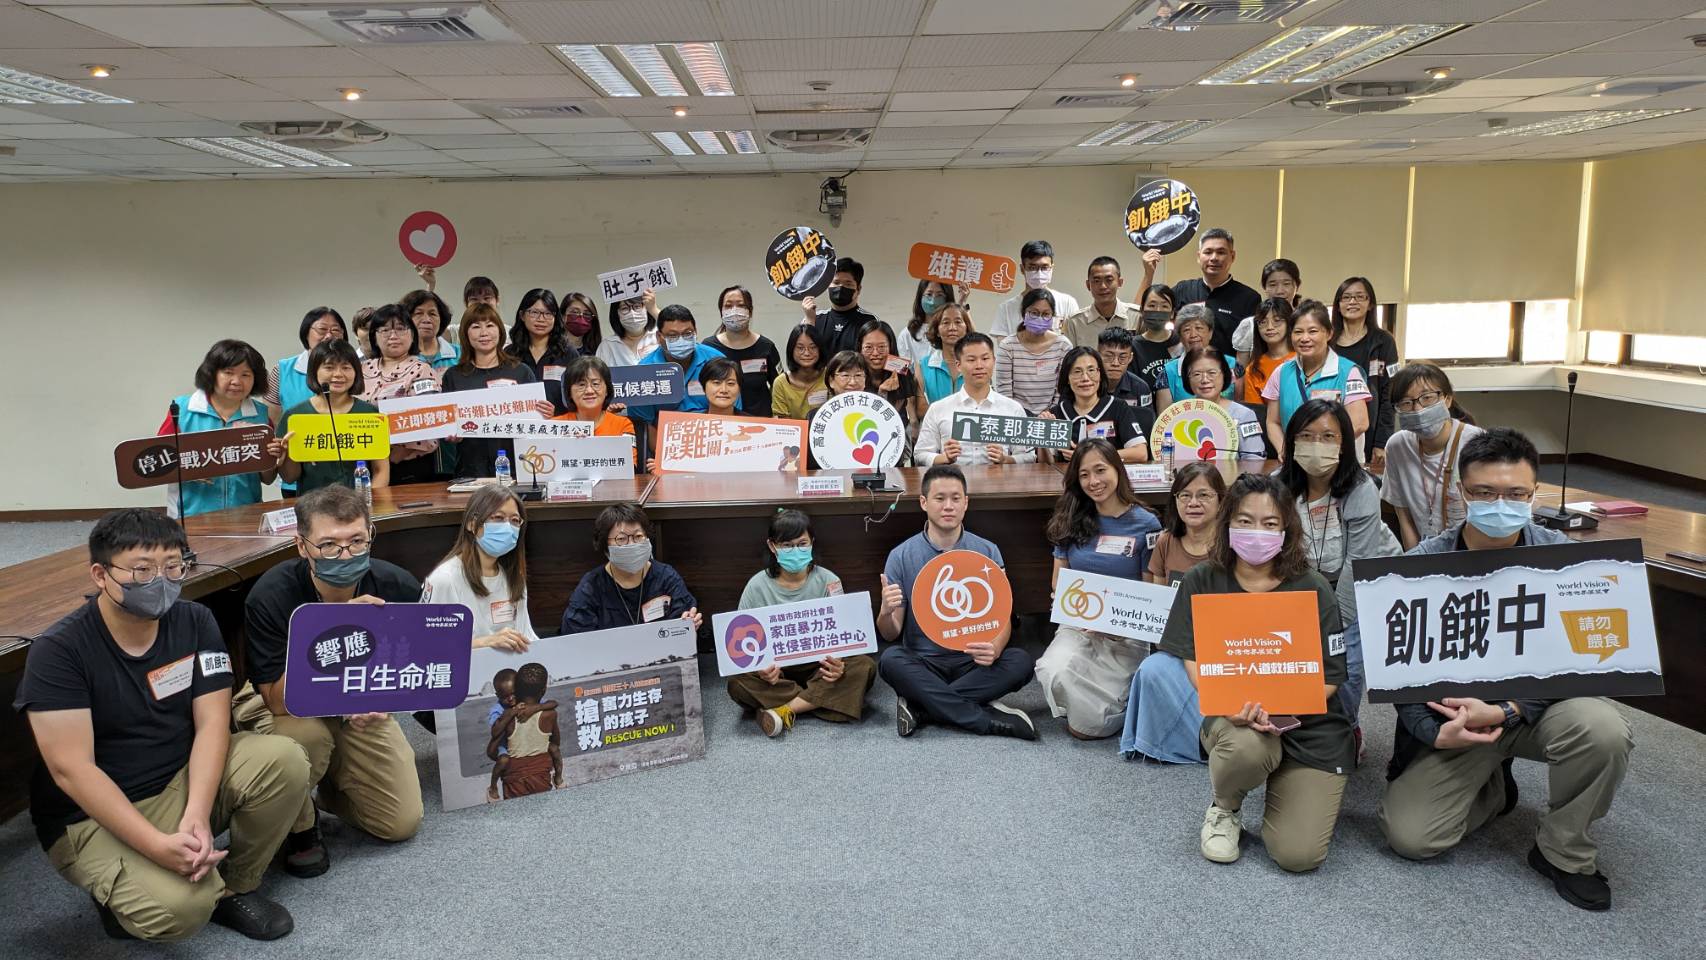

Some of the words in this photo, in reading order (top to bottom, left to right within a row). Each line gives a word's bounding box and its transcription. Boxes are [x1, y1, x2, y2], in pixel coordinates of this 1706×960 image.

[1128, 192, 1191, 232] 飢餓中
[770, 233, 820, 287] 飢餓中
[603, 266, 671, 299] 肚子餓
[813, 394, 895, 448] 高雄市政府社會局
[980, 416, 1069, 441] 泰郡建設
[304, 433, 373, 450] #飢餓中
[980, 434, 1006, 443] TAIJUN
[1010, 437, 1068, 447] CONSTRUCTION
[139, 449, 177, 475] 停止
[180, 443, 261, 470] 戰火衝突
[1556, 581, 1581, 590] World
[1584, 580, 1610, 588] Vision
[769, 606, 834, 623] 高雄市政府社會局
[1111, 606, 1142, 620] World
[1145, 612, 1168, 625] Visio
[1385, 584, 1546, 667] 飢餓中
[1578, 616, 1611, 631] 請勿
[770, 617, 837, 639] 家庭暴力及
[315, 631, 371, 667] 響應
[772, 629, 866, 655] 性侵害防治中心
[1225, 638, 1252, 647] World
[1254, 637, 1281, 646] Vision
[1587, 633, 1621, 649] 餵食
[312, 662, 451, 693] 一日生命糧
[603, 708, 649, 731] 的孩子
[605, 729, 642, 744] RESCUE
[644, 725, 669, 738] NOW
